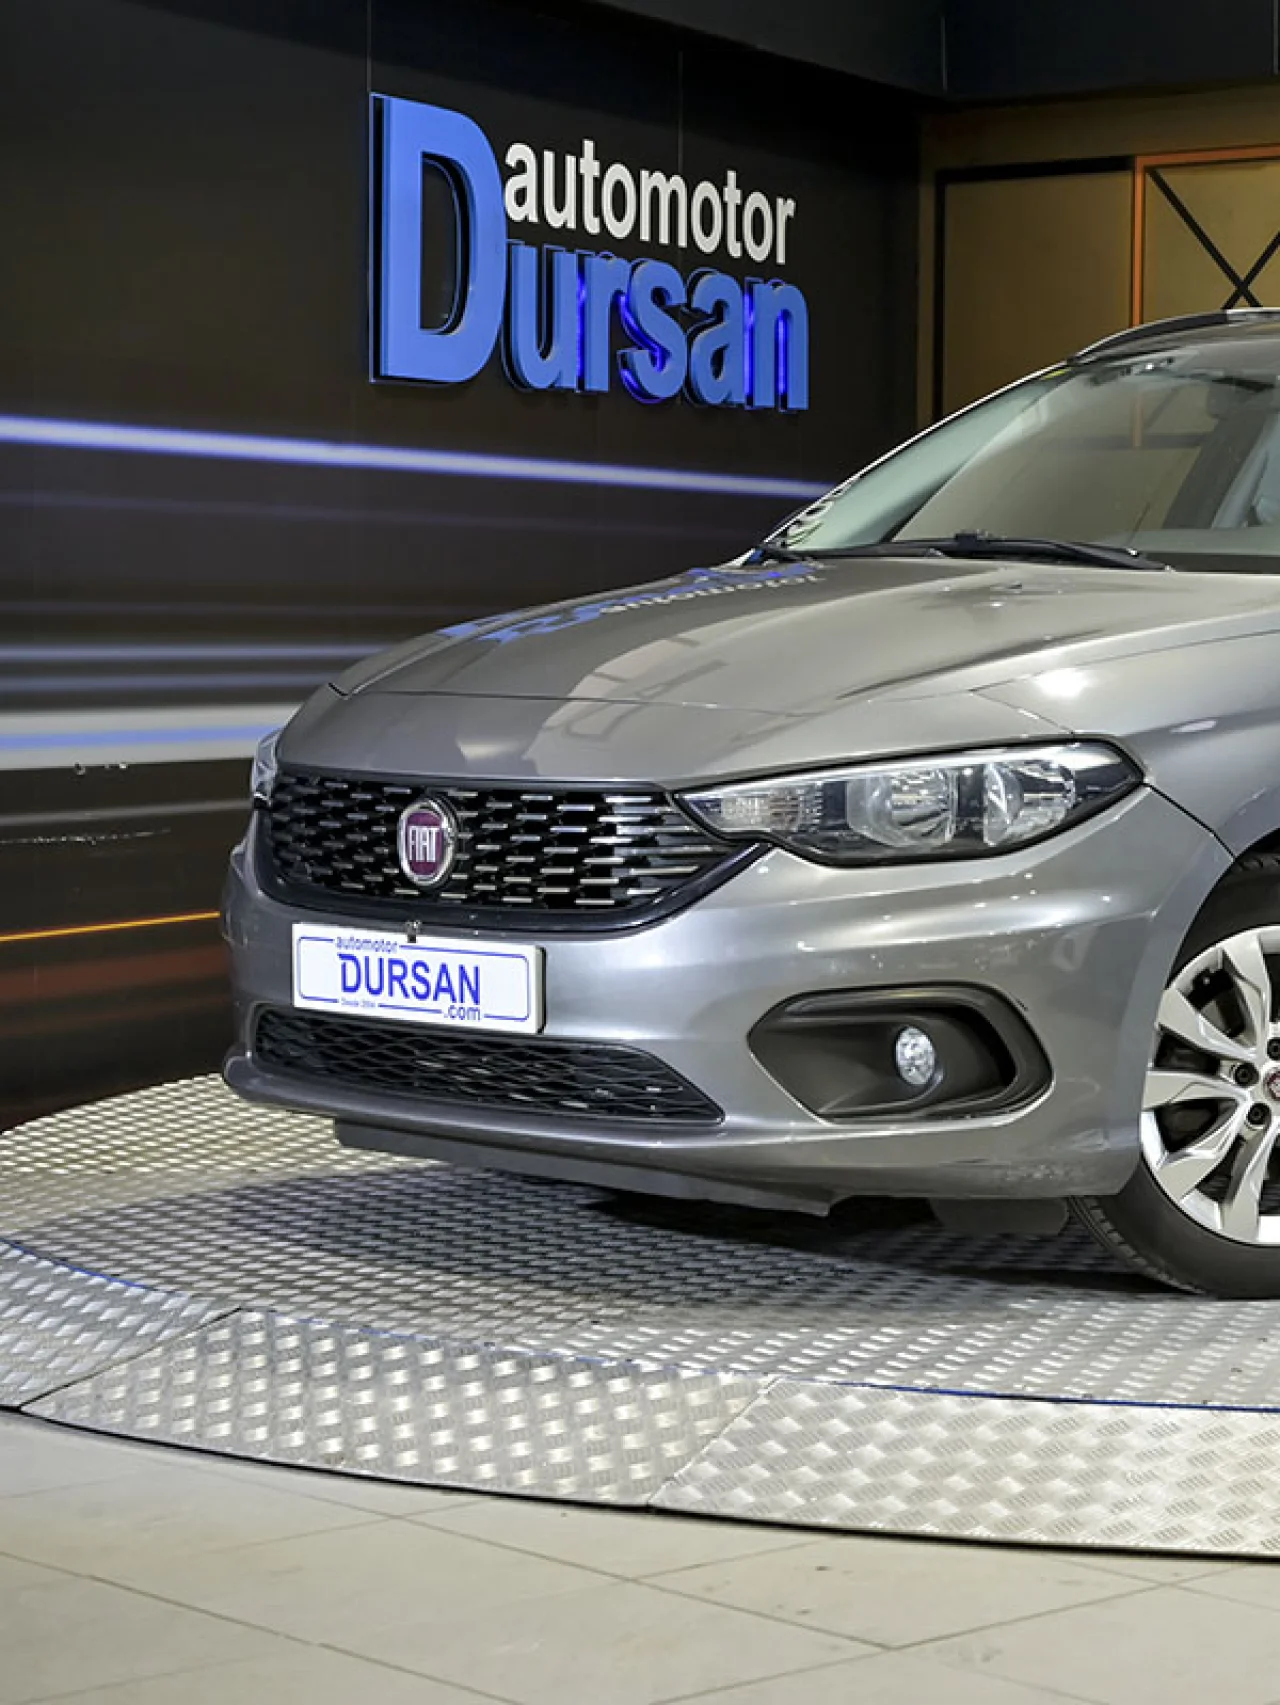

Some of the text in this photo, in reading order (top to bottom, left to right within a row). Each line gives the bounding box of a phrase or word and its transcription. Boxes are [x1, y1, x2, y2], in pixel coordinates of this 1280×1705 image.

[504, 138, 796, 264] automotor
[369, 91, 810, 412] Dursan
[408, 825, 440, 863] FIAT
[336, 936, 398, 954] automotor
[337, 953, 481, 1005] DURSAN
[443, 1004, 481, 1022] .com
